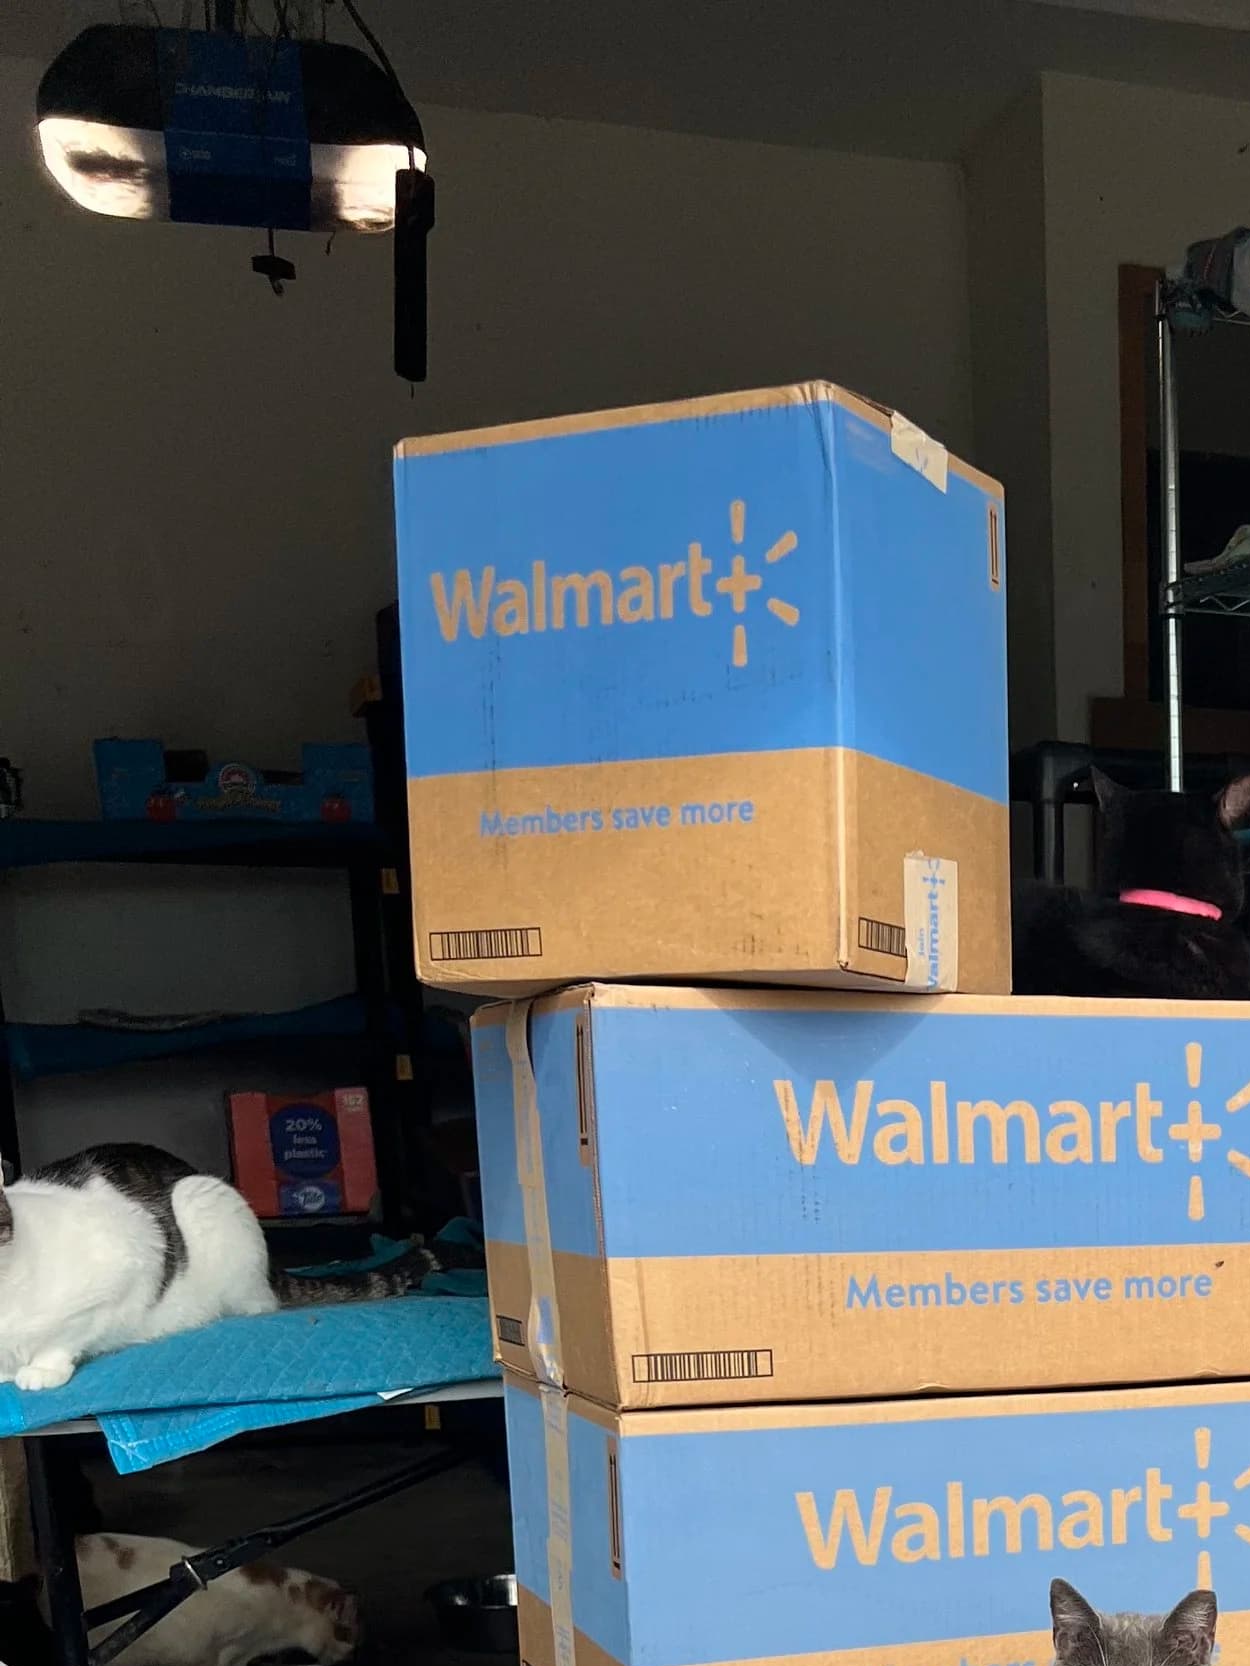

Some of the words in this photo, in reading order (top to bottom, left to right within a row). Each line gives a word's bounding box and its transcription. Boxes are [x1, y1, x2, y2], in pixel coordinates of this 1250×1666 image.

[479, 804, 604, 837] Members
[611, 804, 671, 829] save
[681, 800, 754, 826] more
[847, 1273, 1024, 1310] Members
[1036, 1274, 1112, 1303] save
[1123, 1270, 1213, 1299] more
